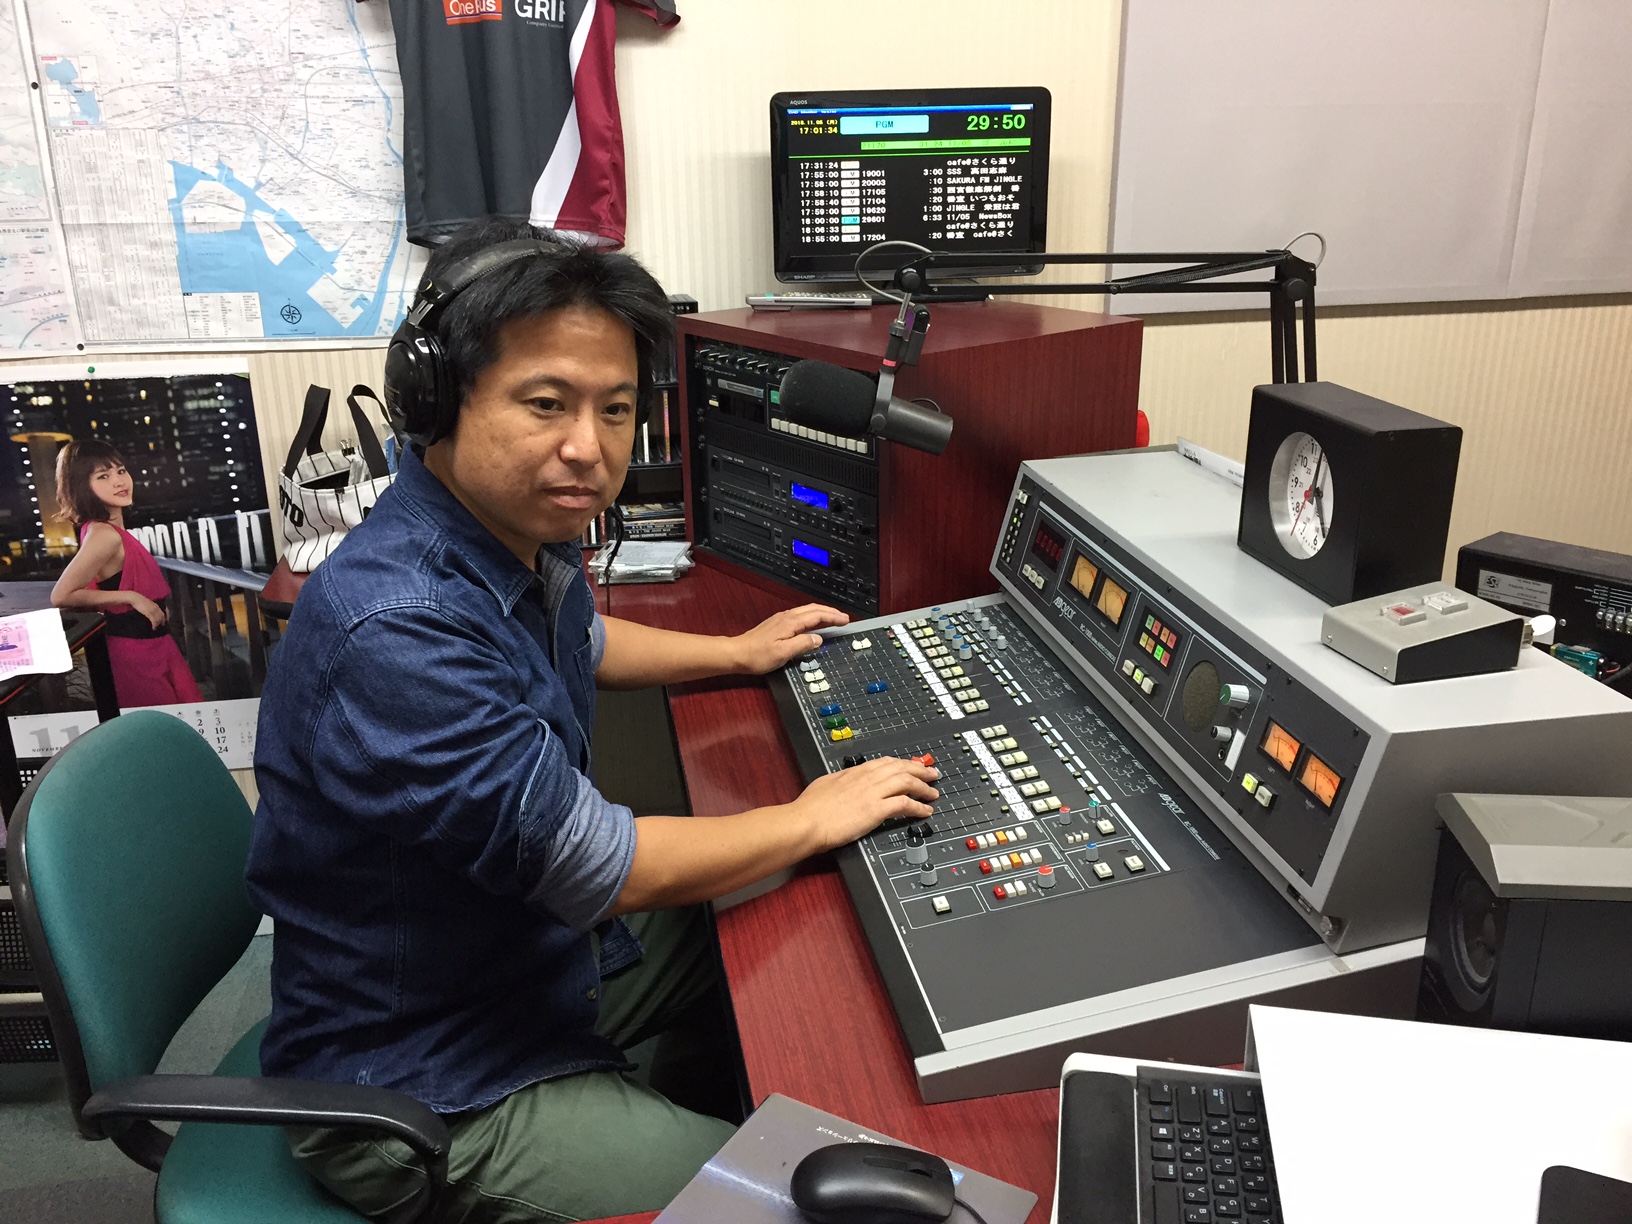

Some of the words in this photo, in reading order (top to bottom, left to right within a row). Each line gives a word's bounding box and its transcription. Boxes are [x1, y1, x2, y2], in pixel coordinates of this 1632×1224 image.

[875, 120, 894, 128] PGM
[966, 113, 1026, 131] 29:50
[799, 126, 838, 134] 17:01:34
[800, 171, 839, 179] 17:55:00
[862, 170, 885, 178] 19001
[923, 168, 943, 176] 3:00
[946, 167, 962, 175] SSS
[800, 180, 839, 188] 17:58:00
[861, 179, 886, 187] 20003
[946, 176, 976, 184] SAKURA
[993, 175, 1023, 183] JINGLE
[800, 189, 839, 197] 17:58:10
[862, 188, 886, 196] 17105
[801, 198, 839, 207] 17:58:40
[862, 197, 886, 205] 17104
[929, 195, 943, 203] :20
[801, 208, 839, 216] 17:59:00
[862, 206, 886, 214] 19620
[923, 205, 943, 213] 1:00
[946, 204, 975, 212] JINGLE
[801, 217, 839, 225] 18:00:00
[922, 214, 942, 222] 6:33
[946, 213, 970, 221] 11/05
[978, 212, 1012, 220] NewsBox
[801, 226, 839, 234] 18:06:33
[801, 235, 839, 243] 18:55:00
[862, 234, 886, 242] 17204
[928, 231, 942, 239] :20
[1311, 442, 1318, 455] 11
[1300, 454, 1308, 468] 10
[1305, 467, 1312, 475] 22
[1294, 476, 1299, 488] 9
[1295, 501, 1300, 513] 8
[1313, 535, 1318, 546] 6
[197, 718, 203, 726] 2
[215, 717, 221, 726] 3
[215, 726, 226, 735] 10
[216, 736, 226, 744] 17
[217, 746, 228, 754] 24
[1251, 1136, 1259, 1145] W
